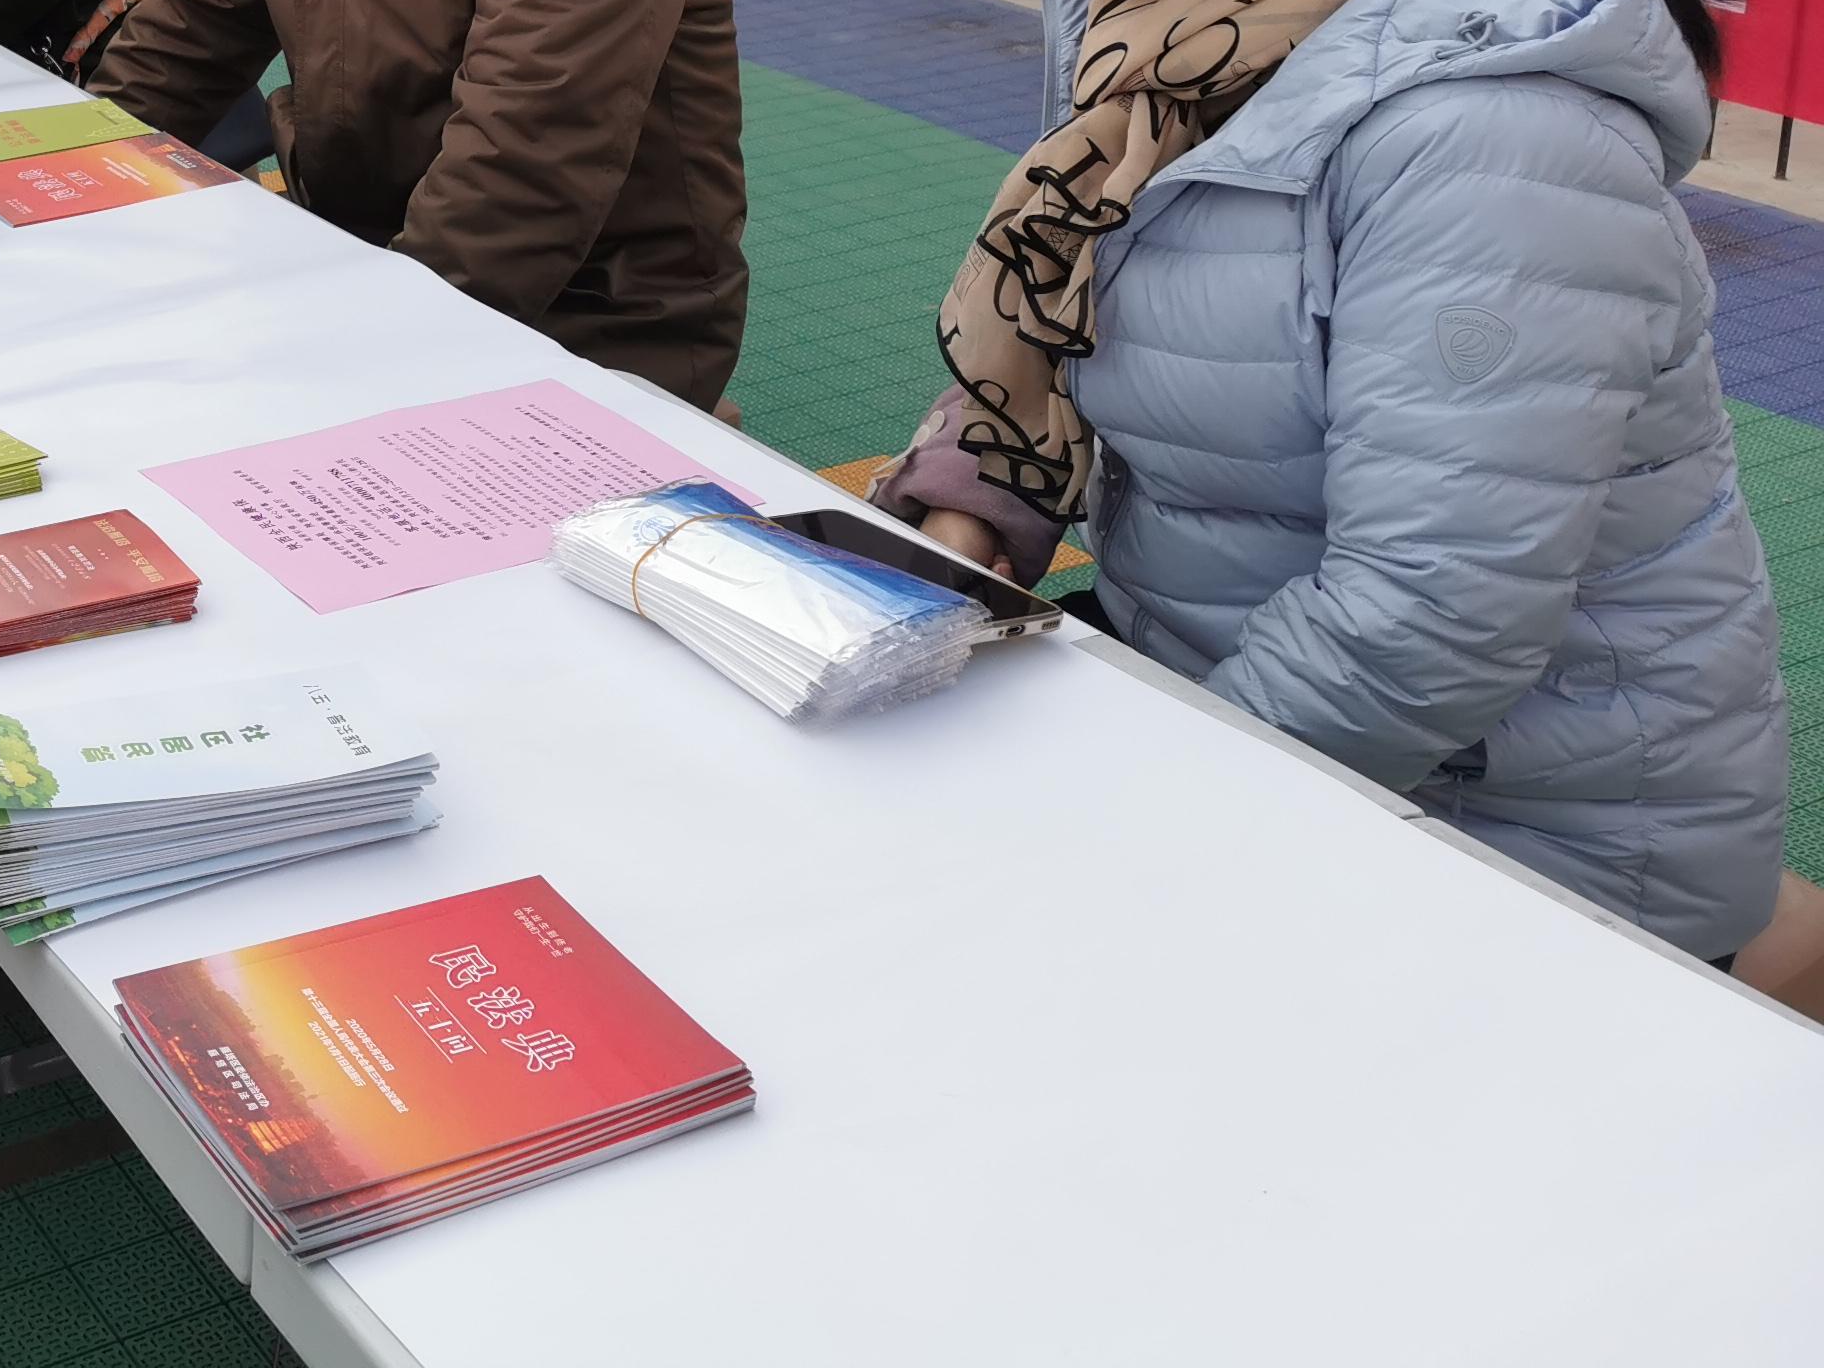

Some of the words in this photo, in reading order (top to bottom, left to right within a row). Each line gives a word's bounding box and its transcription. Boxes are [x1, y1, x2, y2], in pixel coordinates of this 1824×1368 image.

[225, 498, 306, 551] 陕西全民健康保
[80, 723, 274, 765] 社区居民篇
[410, 996, 476, 1057] 五十问
[429, 944, 578, 1074] 民法典
[307, 1020, 367, 1090] 2021年1月1日起施行
[345, 1018, 396, 1073] 2020年5月28日
